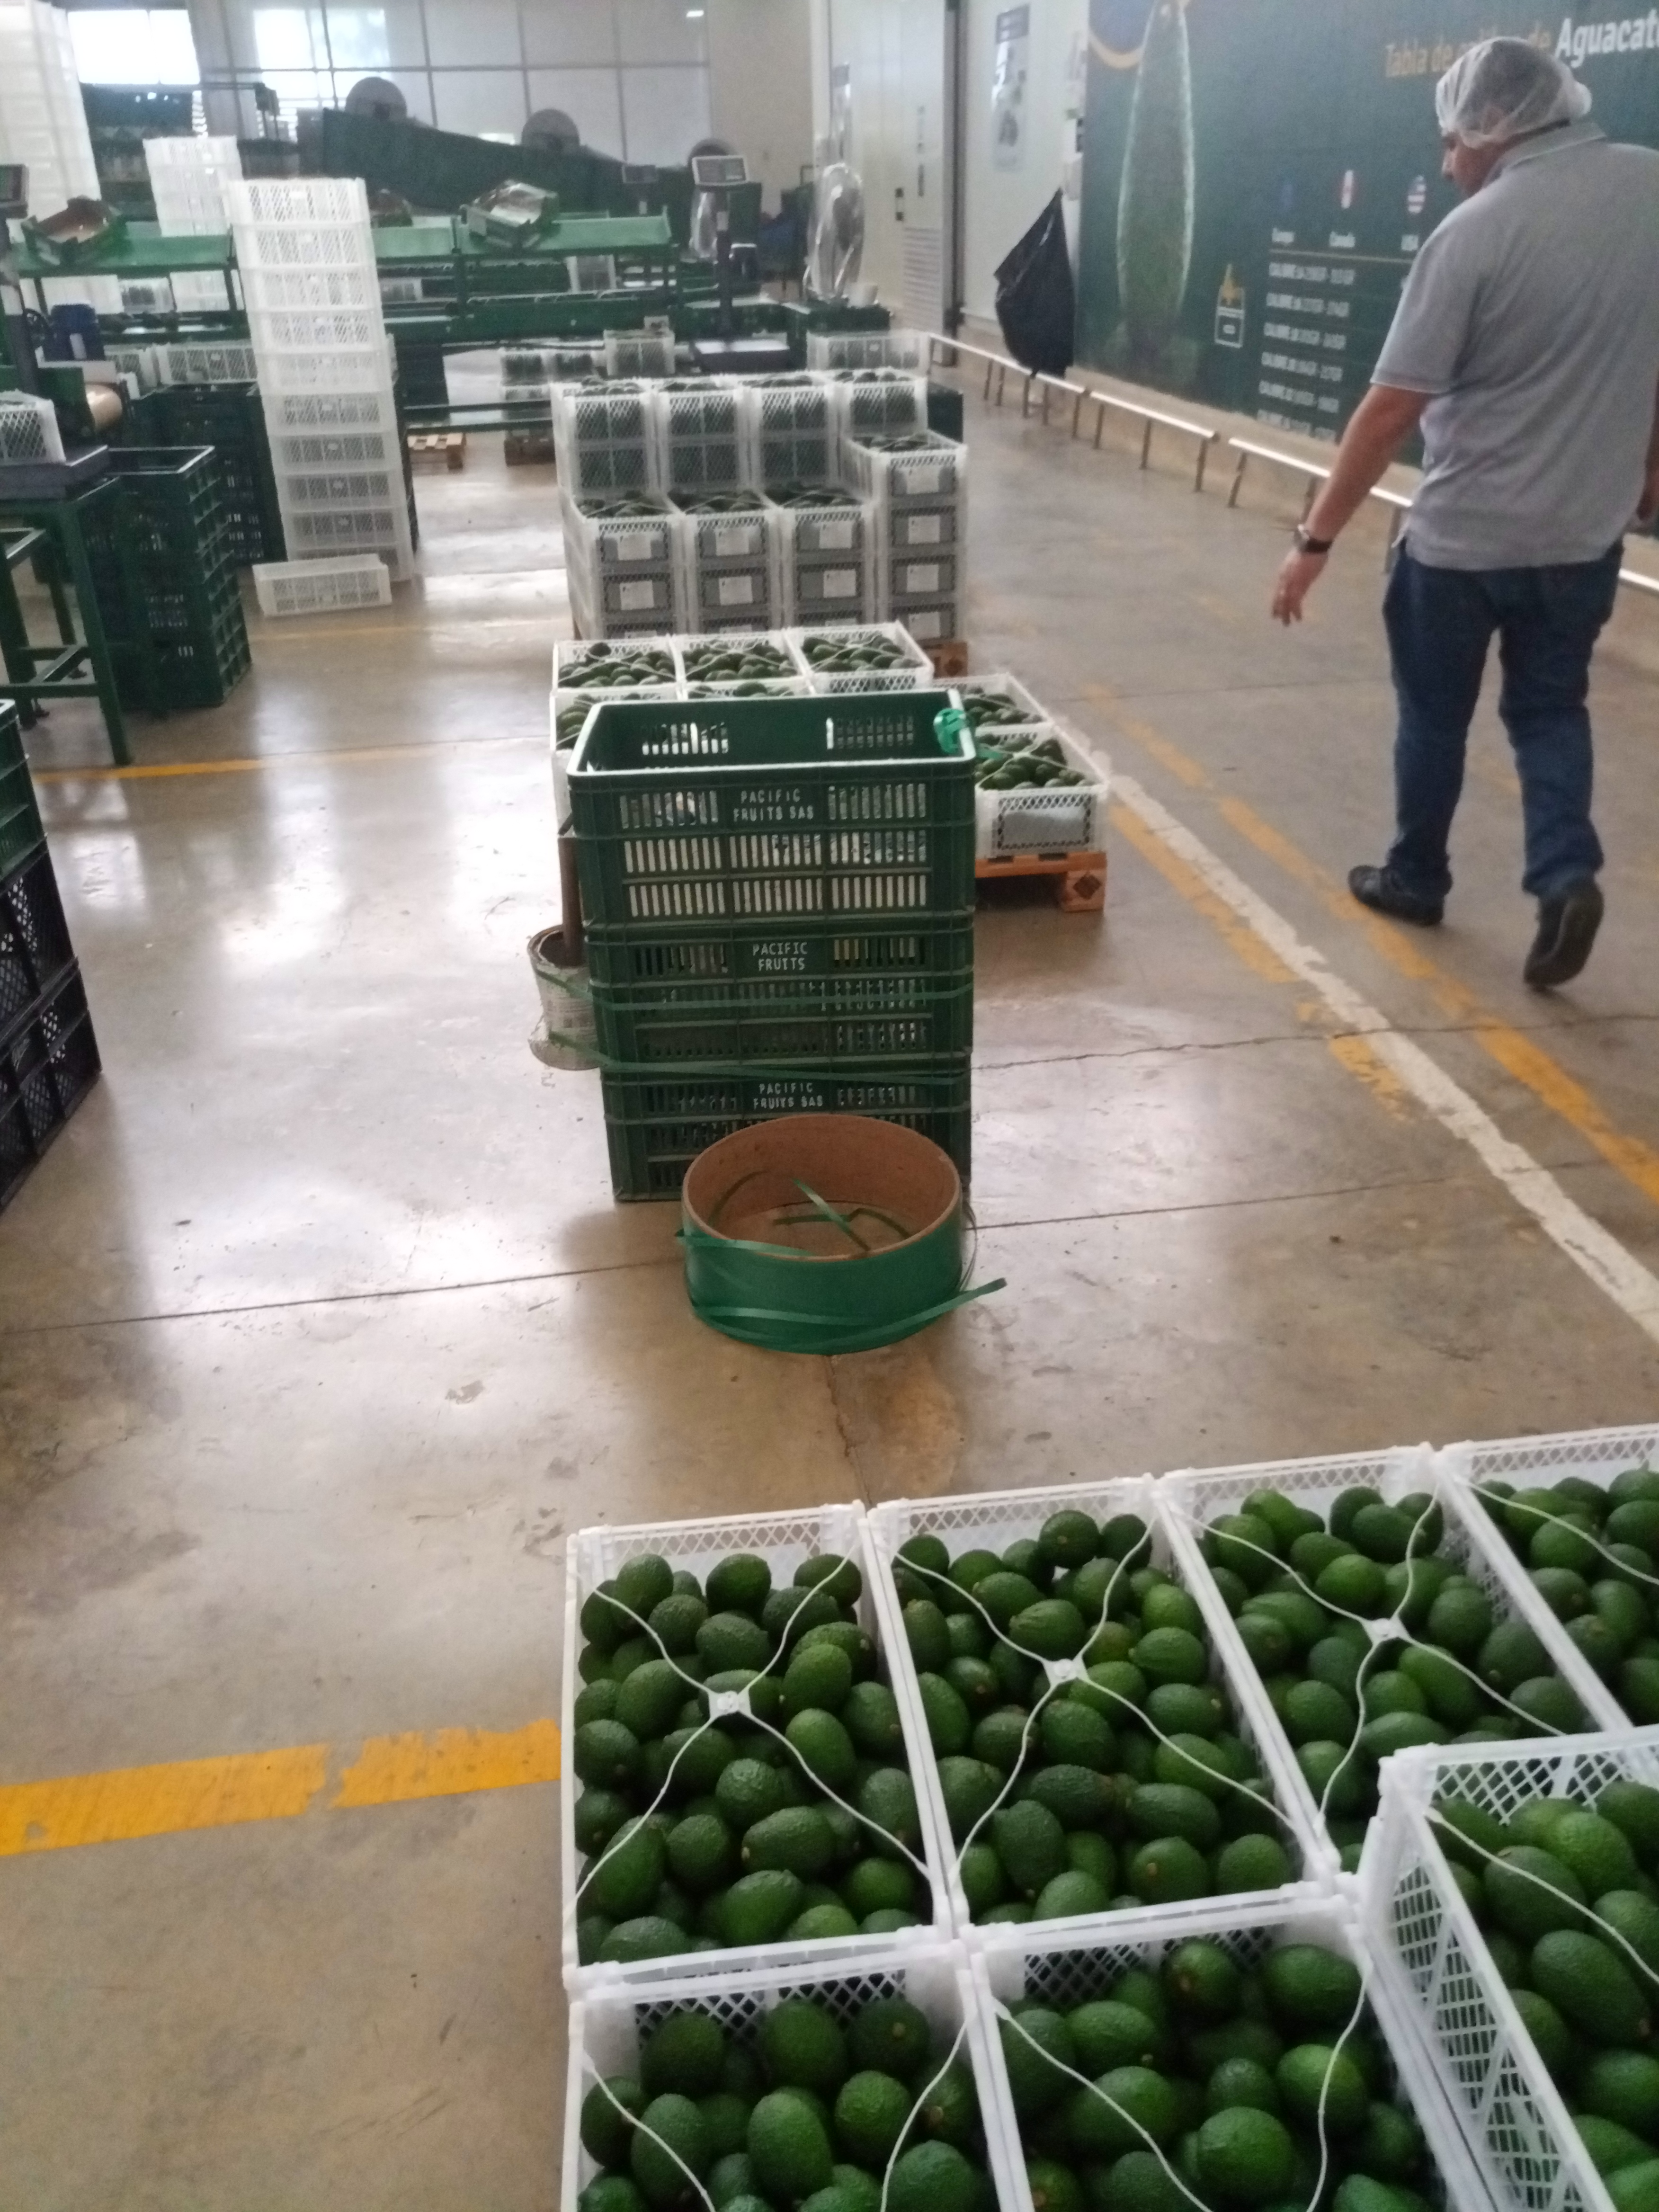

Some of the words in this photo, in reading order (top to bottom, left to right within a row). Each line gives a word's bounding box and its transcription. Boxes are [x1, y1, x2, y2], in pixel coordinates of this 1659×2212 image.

[1555, 9, 1659, 68] Aguacat
[741, 788, 801, 804] PACIFIC
[734, 805, 783, 822] FRUITS
[790, 805, 814, 821] SAS
[752, 942, 808, 956] PACIFIC
[758, 957, 805, 971] FRUITS
[759, 1082, 813, 1095] PACIFIC
[753, 1097, 794, 1110] FRUITS
